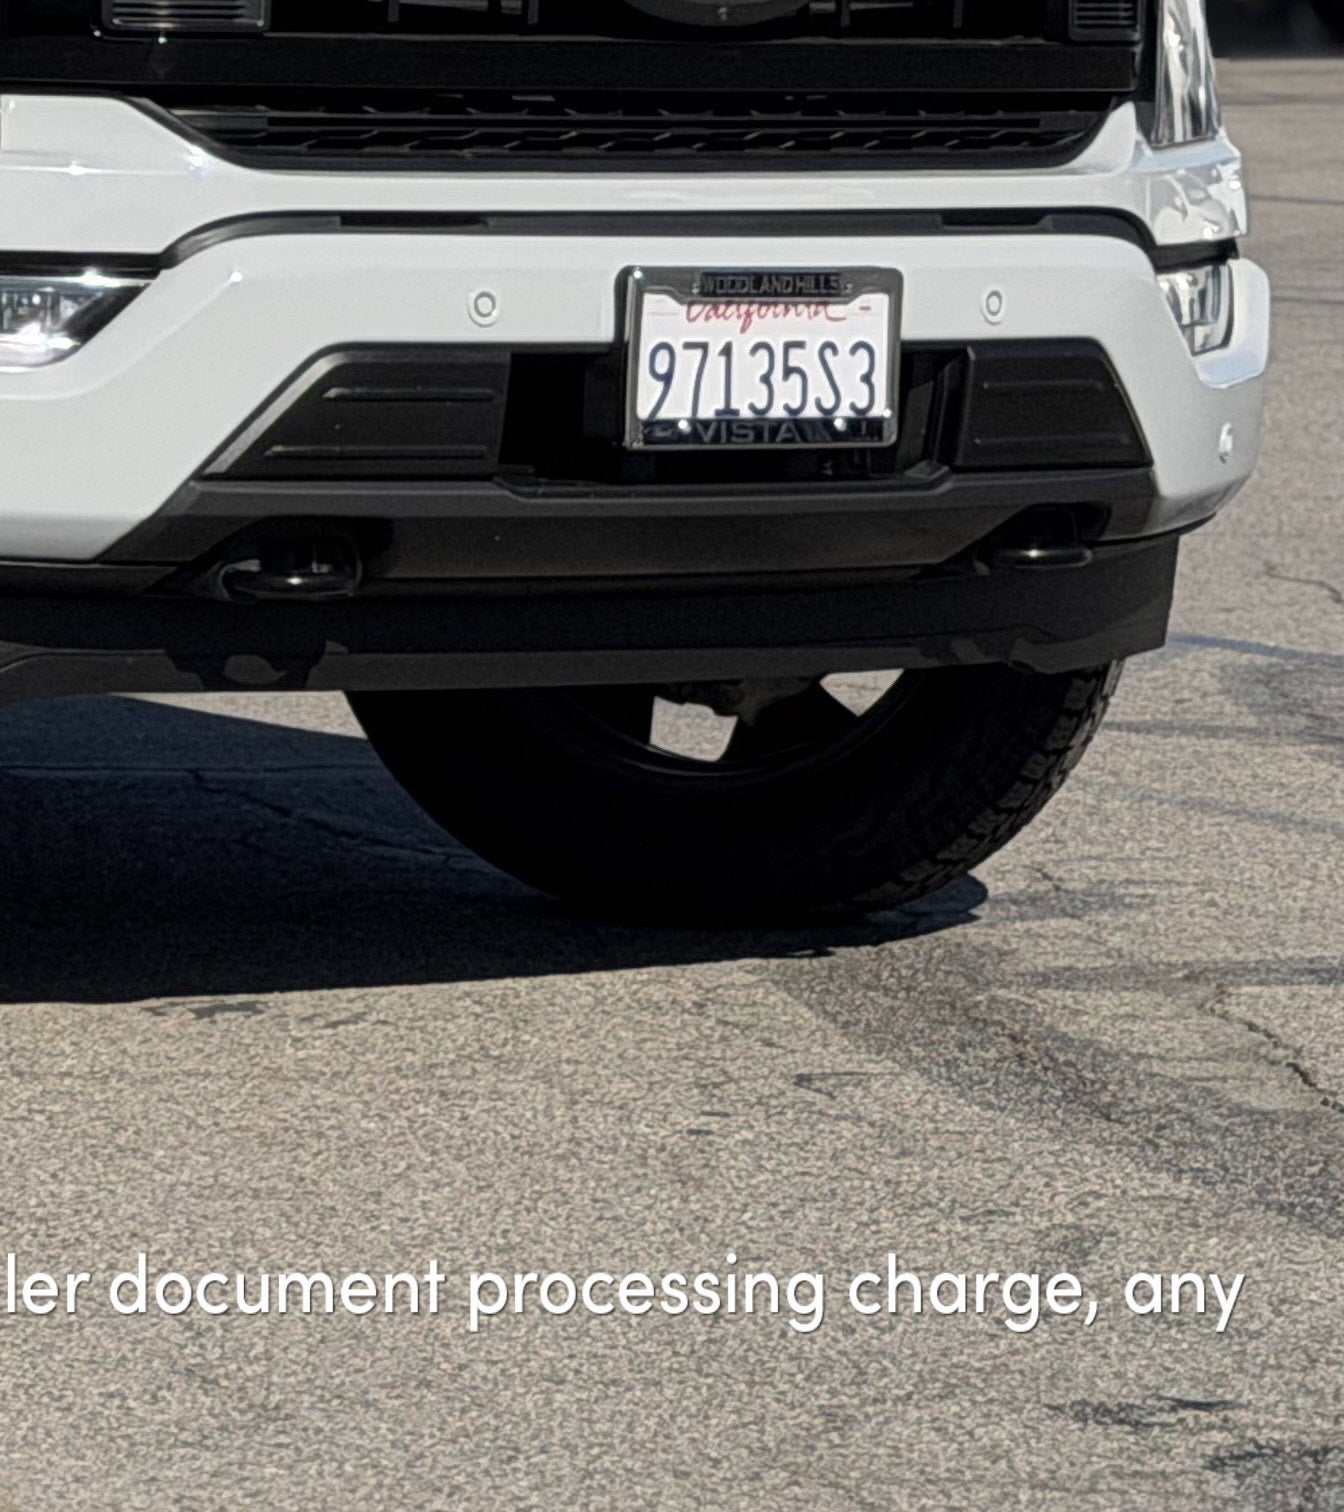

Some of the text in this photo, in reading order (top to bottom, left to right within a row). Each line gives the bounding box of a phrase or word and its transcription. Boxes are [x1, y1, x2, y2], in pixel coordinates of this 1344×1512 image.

[703, 274, 795, 294] WOODLAND
[648, 340, 876, 420] 97135S3
[696, 420, 801, 443] VISTA
